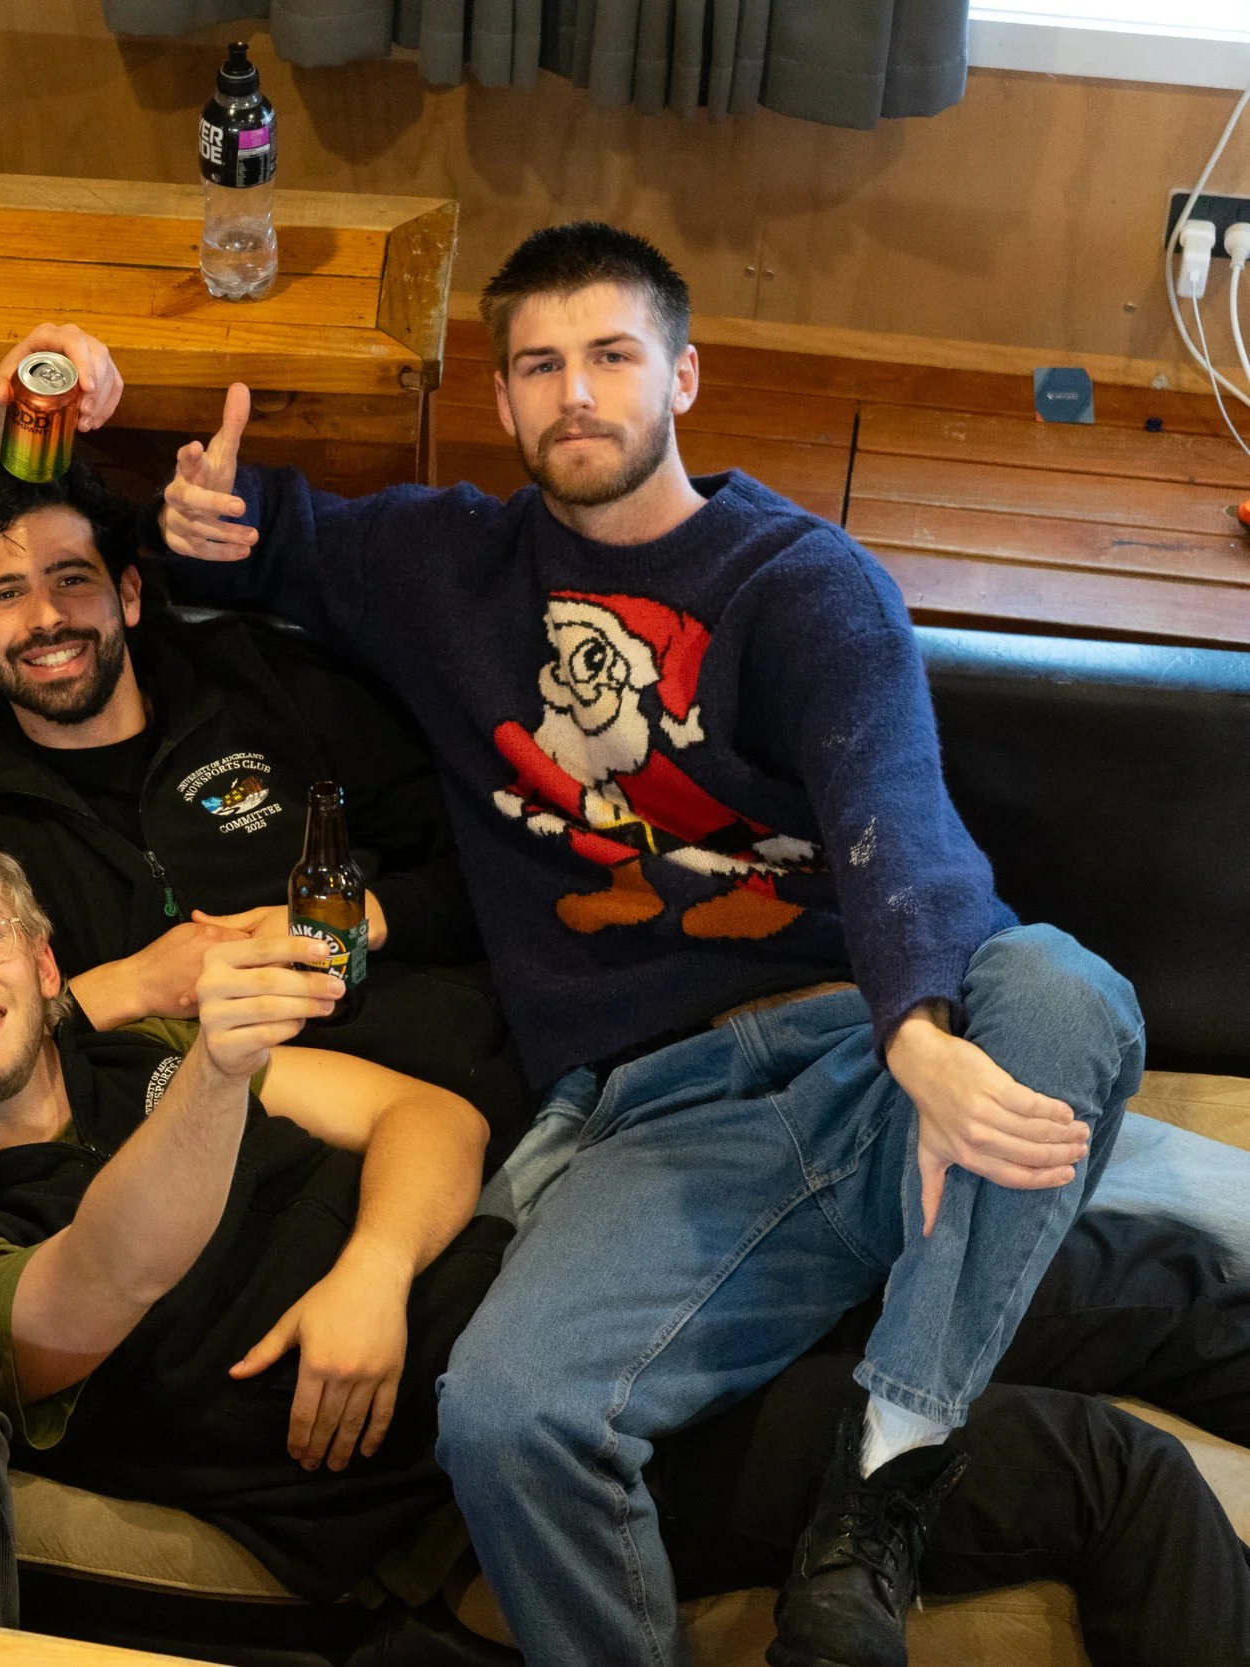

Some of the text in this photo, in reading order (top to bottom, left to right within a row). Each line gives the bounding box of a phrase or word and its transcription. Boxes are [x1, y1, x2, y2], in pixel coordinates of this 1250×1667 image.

[199, 118, 224, 147] ER
[199, 139, 223, 165] DE
[177, 752, 264, 792] UNIVERSITY OF AUCKLAND
[184, 759, 271, 802] SNOWSPORTS CLUB
[219, 803, 282, 834] COMMITTEE
[245, 819, 267, 834] 2025
[290, 923, 340, 954] AIKATO
